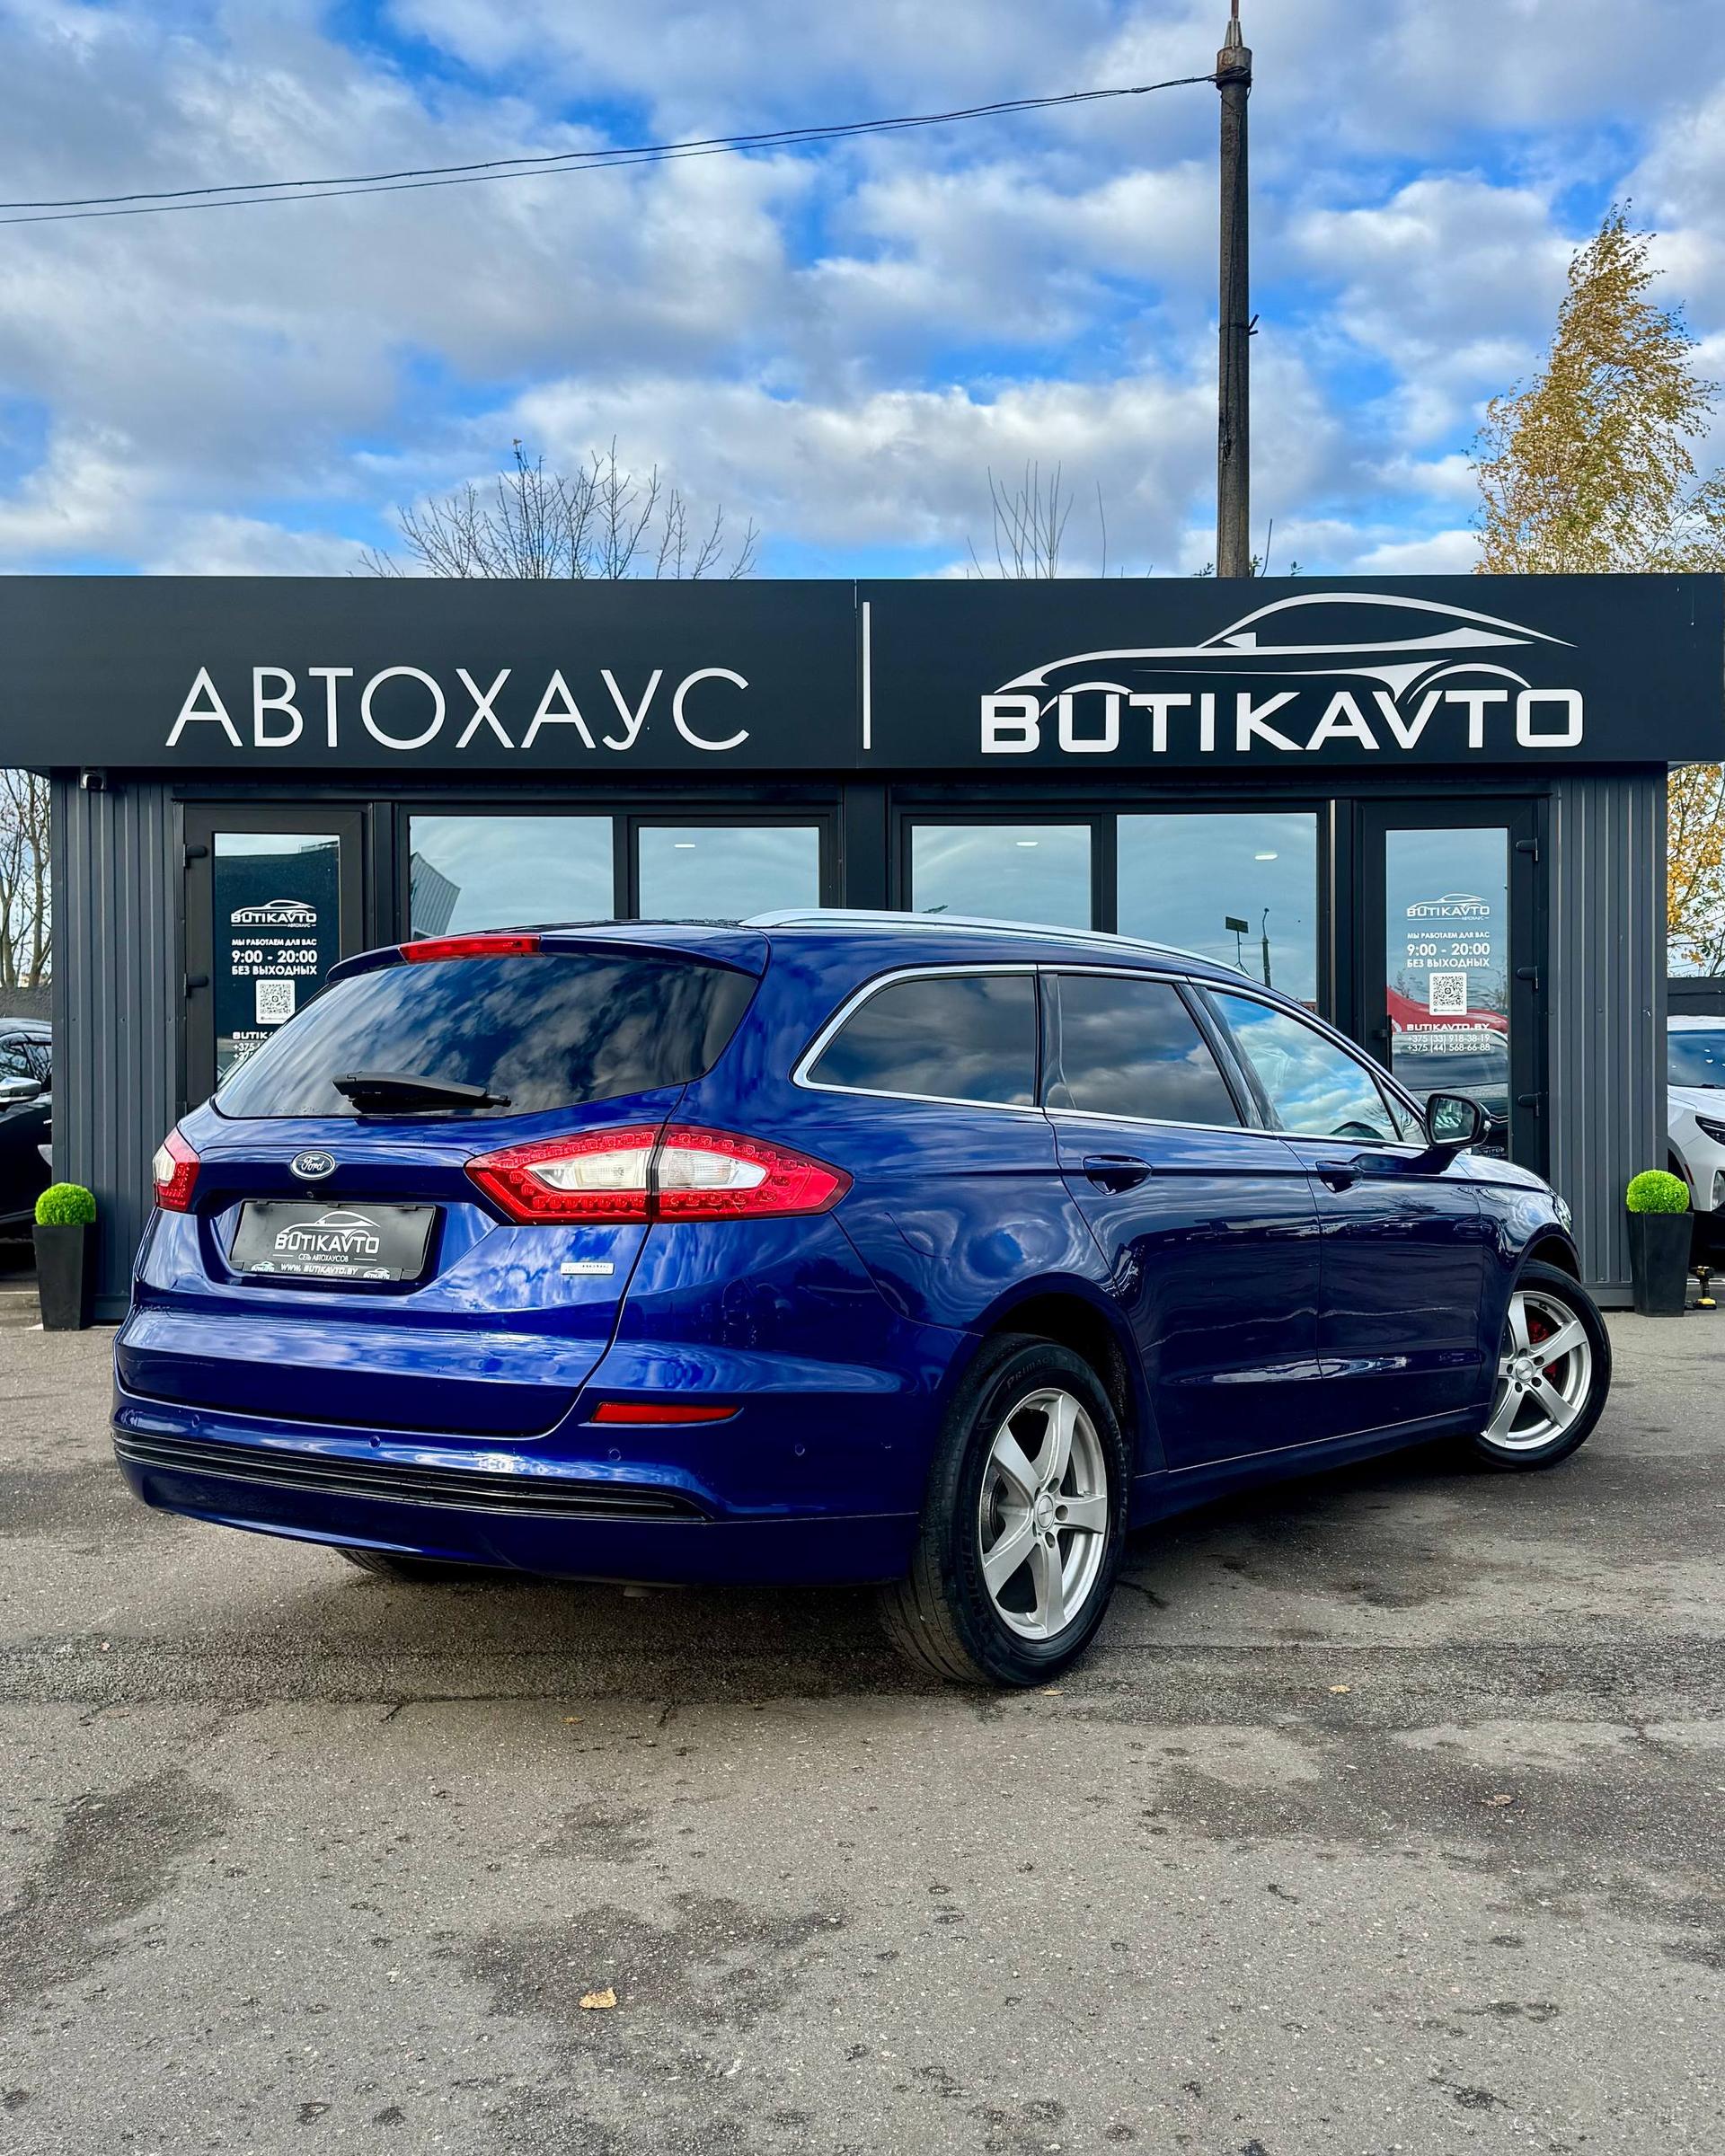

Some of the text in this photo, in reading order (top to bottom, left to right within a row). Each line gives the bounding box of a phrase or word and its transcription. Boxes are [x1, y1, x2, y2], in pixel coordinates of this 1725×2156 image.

[165, 666, 749, 750] АВТОХАУС
[981, 687, 1584, 754] BUTIKAVTO
[1407, 906, 1490, 916] BUTIKAVTO
[231, 912, 317, 923] BUTIKAVTO
[1407, 943, 1437, 956] 9:00
[1451, 942, 1490, 956] 20:00
[232, 950, 263, 963] 9:00
[277, 950, 317, 963] 20:00
[1407, 958, 1490, 968] БЕЗ ВЫХОДНЫХ
[232, 965, 317, 976] БЕЗ ВЫХОДНЫХ
[1406, 1023, 1490, 1031] BUTIKAVTO.BY
[1408, 1034, 1428, 1043] +375
[1449, 1034, 1491, 1043] 918-38-19
[1408, 1043, 1491, 1053] +375 (44) 568-66-88
[301, 1155, 324, 1171] Ford
[274, 1232, 380, 1254] BUTIKAVTO
[280, 1263, 358, 1276] WWW. BUTIKAVTO.BY
